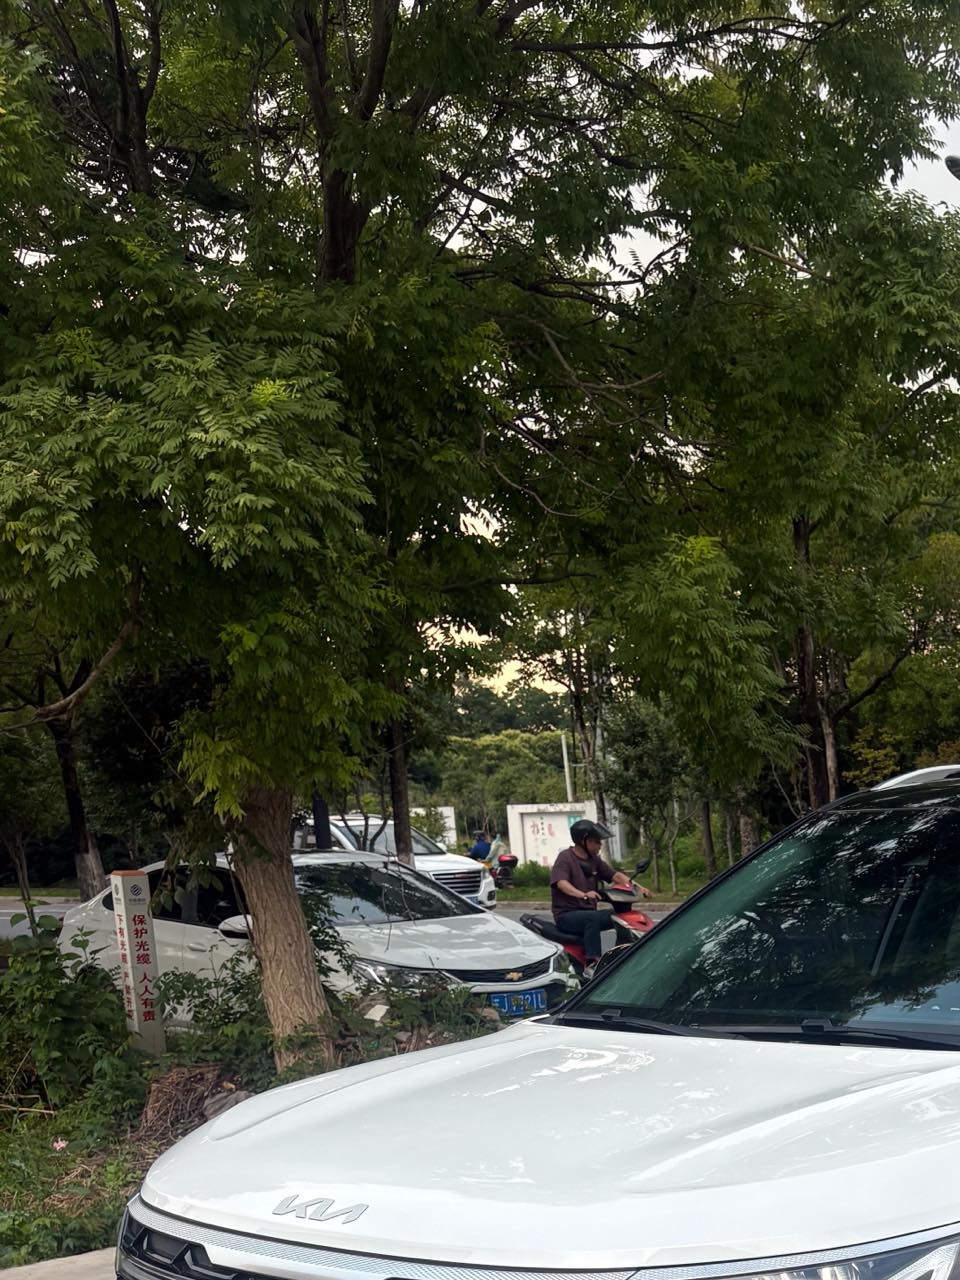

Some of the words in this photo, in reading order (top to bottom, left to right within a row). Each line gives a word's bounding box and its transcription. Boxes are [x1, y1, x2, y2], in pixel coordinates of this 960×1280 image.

[132, 914, 152, 965] 保护光缆
[139, 972, 156, 1022] 人人有责
[271, 1194, 370, 1225] KIA
